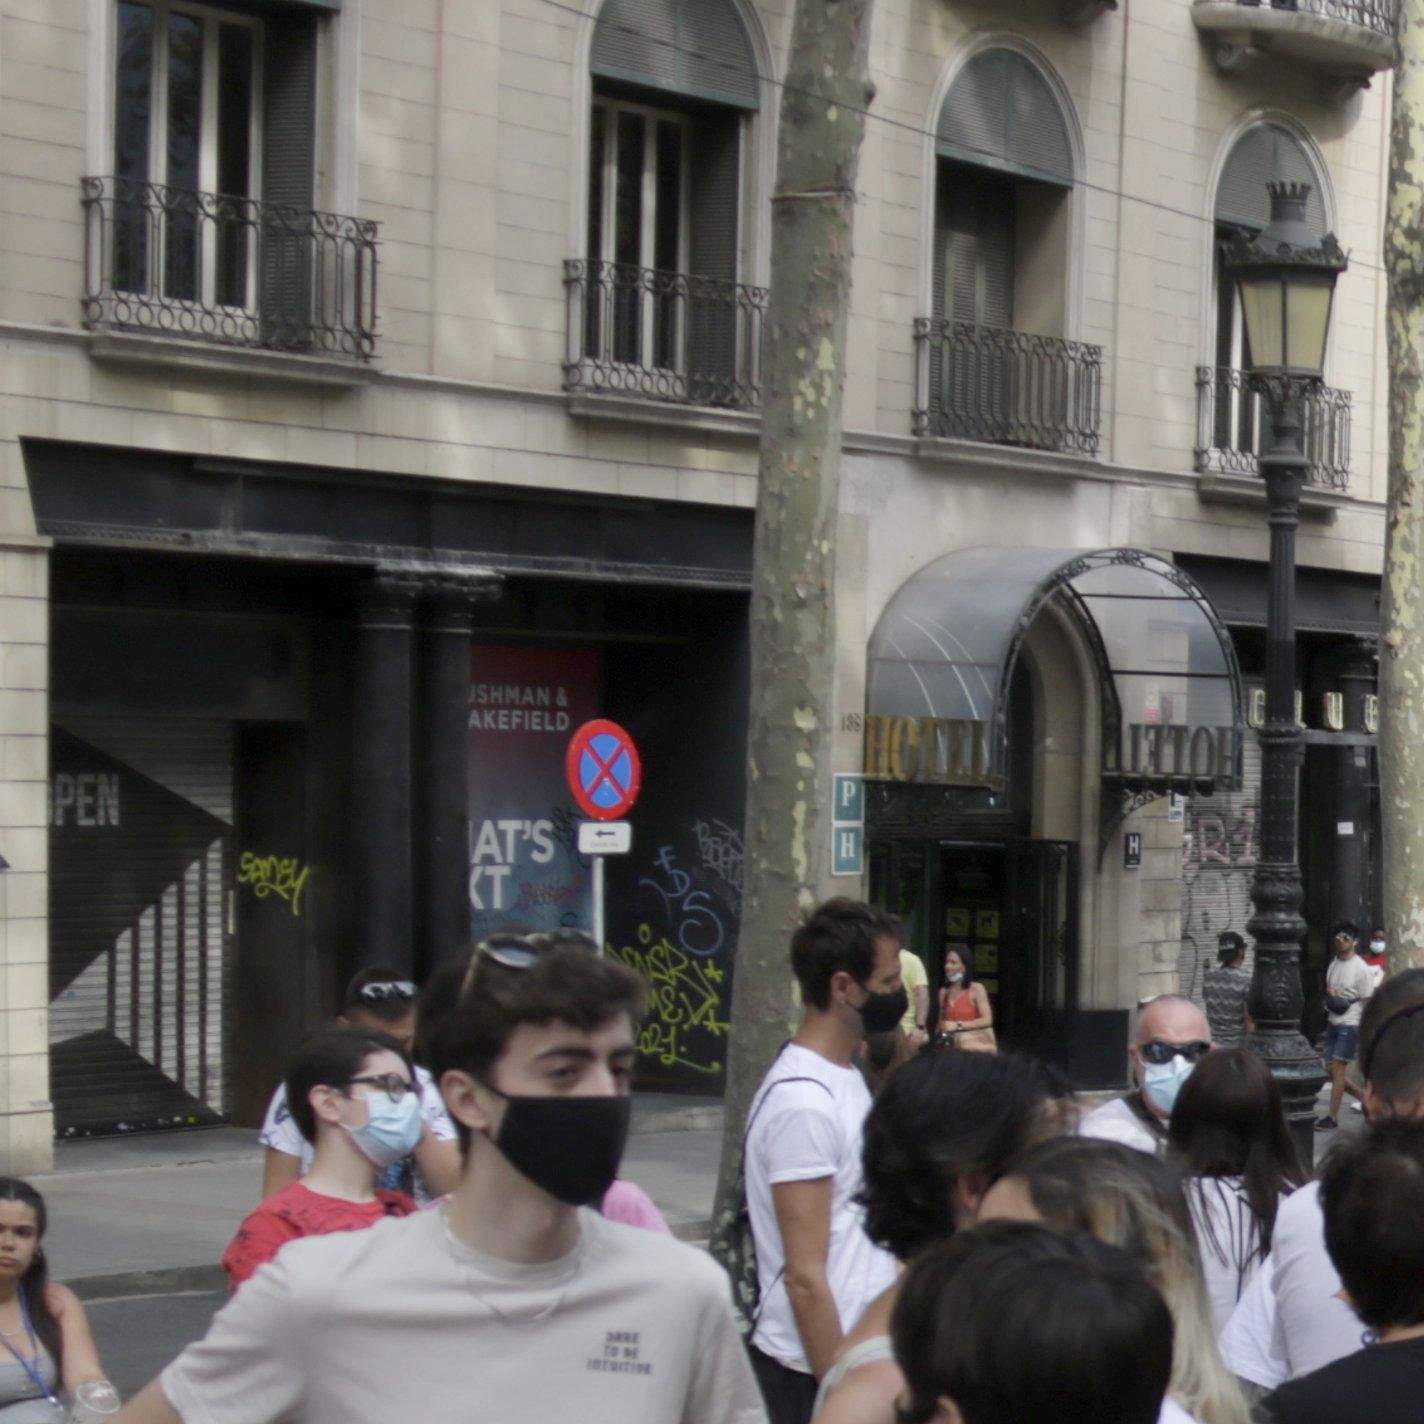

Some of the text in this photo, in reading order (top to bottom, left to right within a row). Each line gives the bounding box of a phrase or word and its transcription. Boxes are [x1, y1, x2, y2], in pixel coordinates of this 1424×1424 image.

[468, 709, 570, 731] AKEFIELD
[50, 775, 119, 825] PEN
[842, 781, 855, 806] P
[469, 819, 554, 863] AT'S
[840, 832, 855, 857] H
